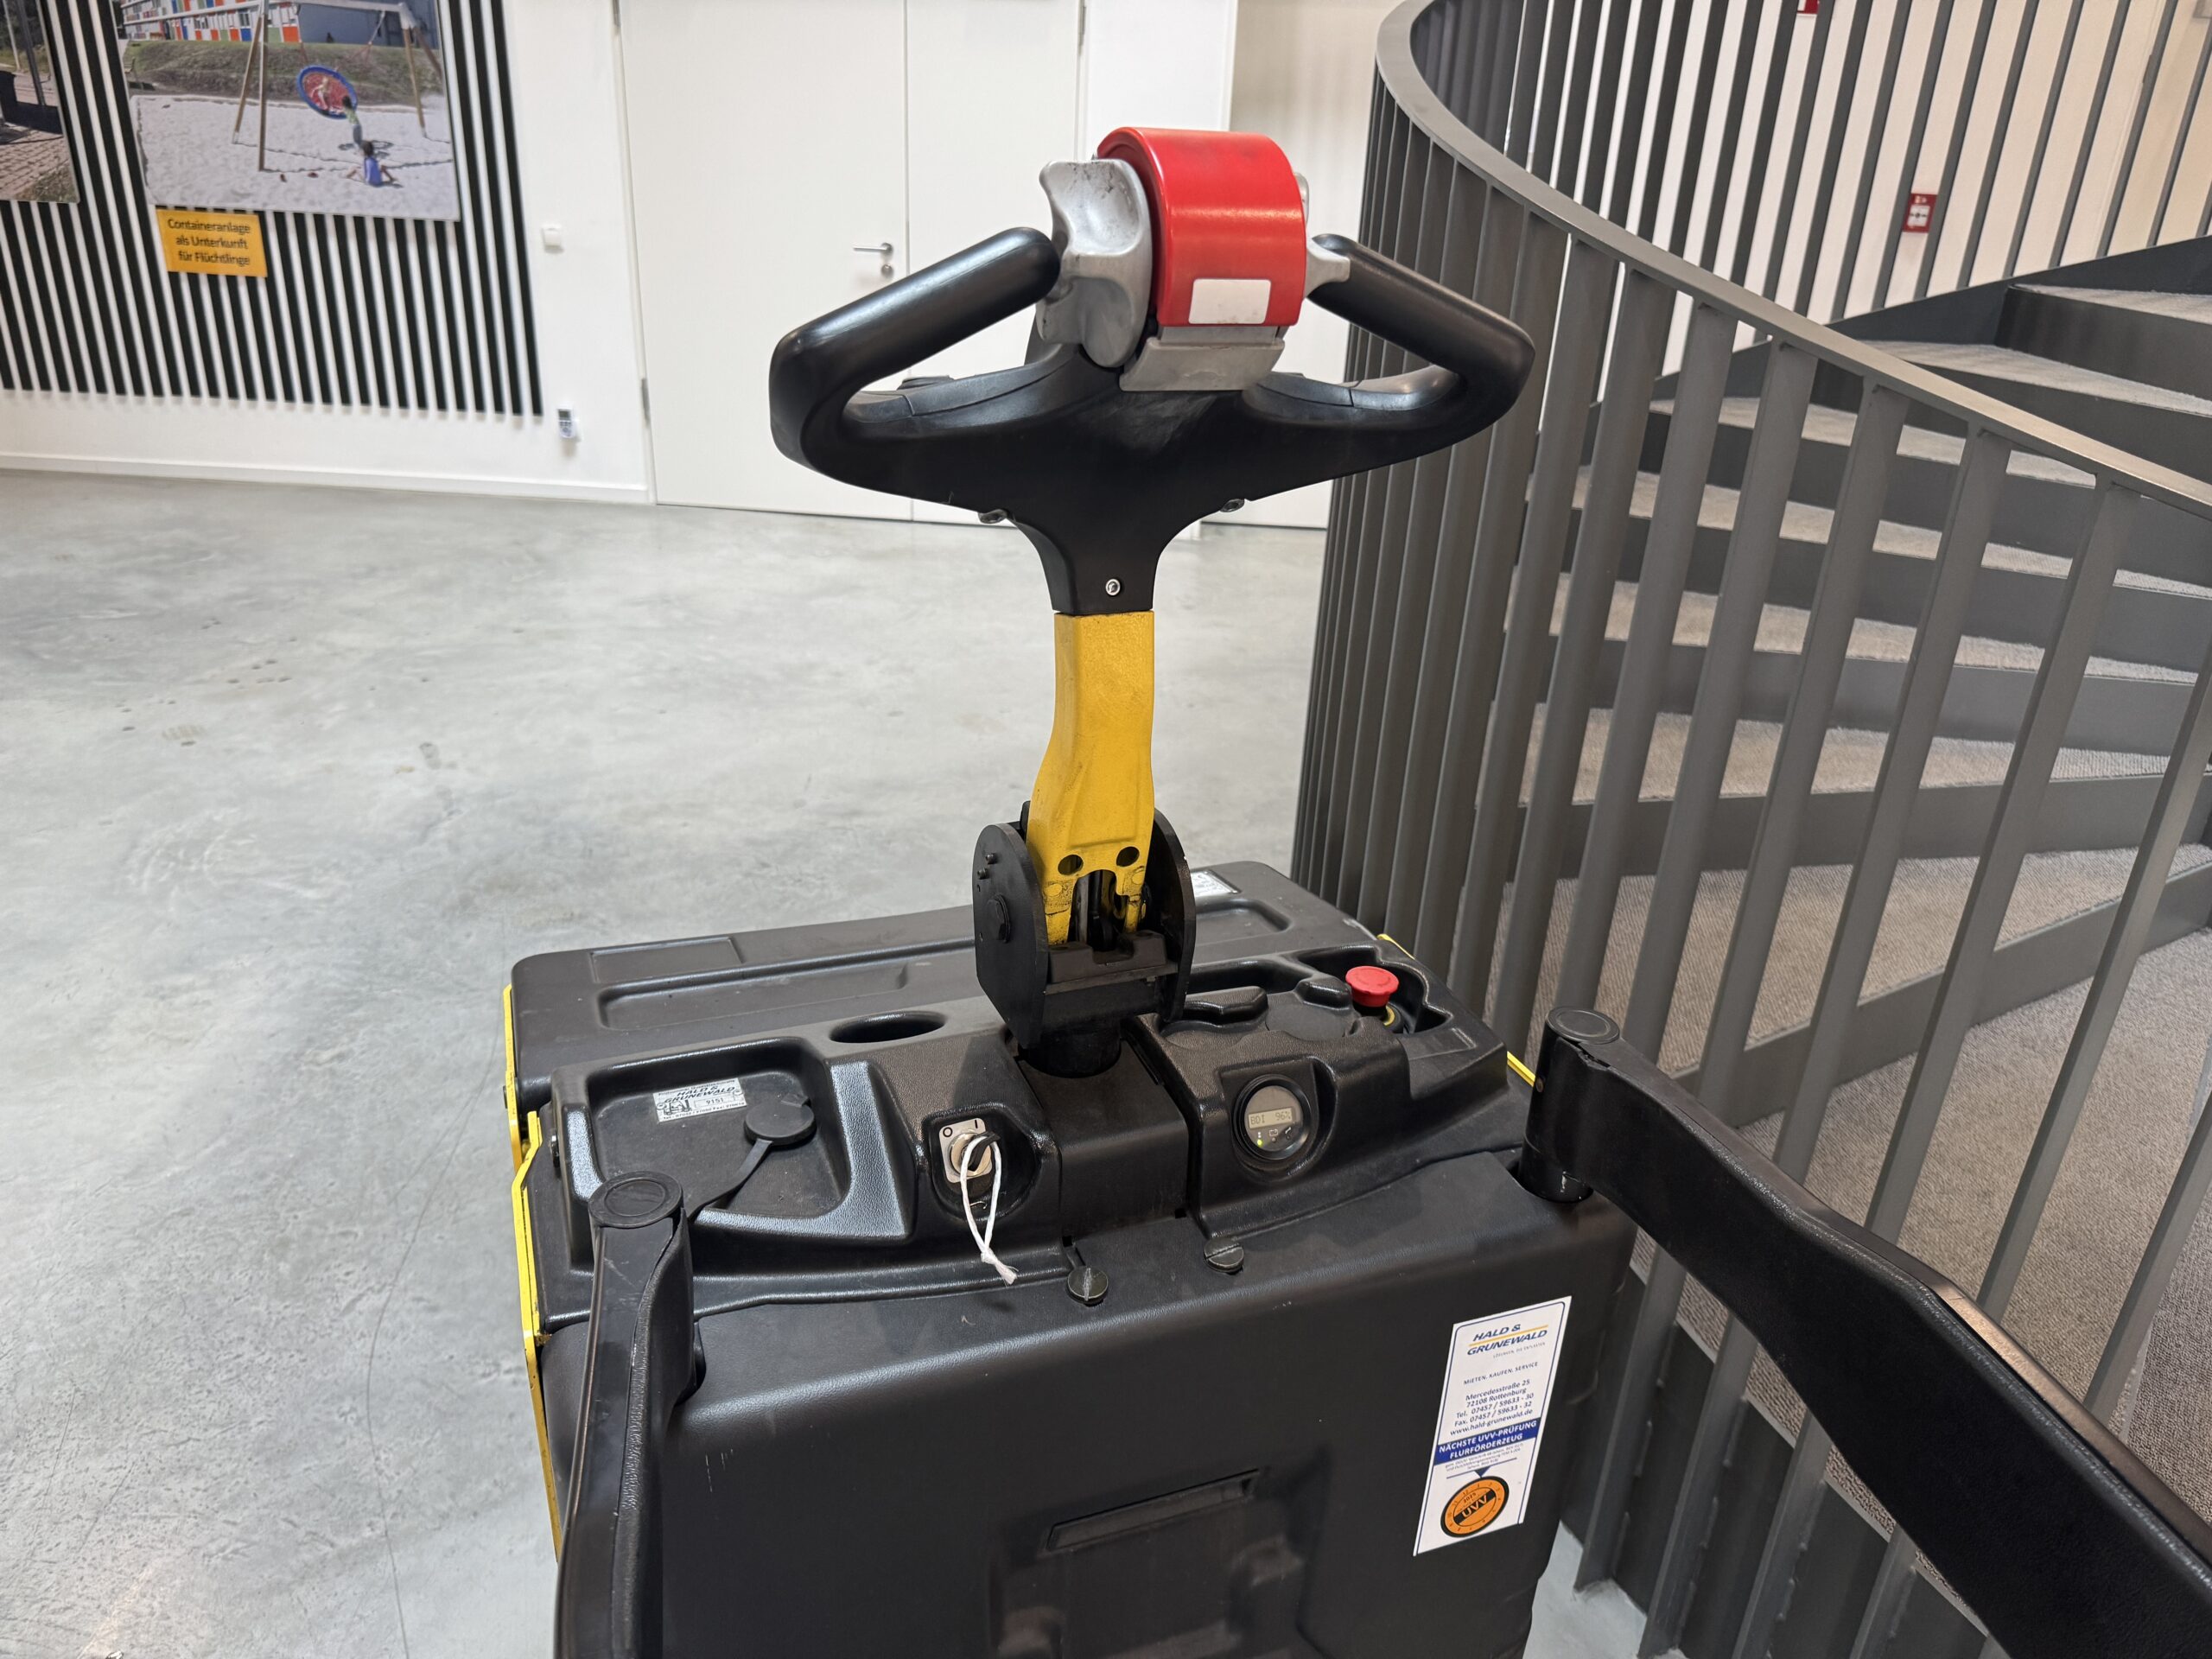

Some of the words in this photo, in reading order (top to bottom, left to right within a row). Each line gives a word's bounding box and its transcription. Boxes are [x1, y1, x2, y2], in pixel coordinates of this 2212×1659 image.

[168, 219, 251, 235] Containeranlage
[176, 235, 189, 245] als
[192, 237, 248, 249] Unterkunft
[179, 251, 192, 261] für
[195, 252, 250, 267] Flüchtlinge
[664, 1087, 735, 1103] GRUNEWALD
[677, 1087, 709, 1096] HALD
[1250, 1115, 1265, 1125] BDI
[1275, 1110, 1291, 1121] 96%
[1473, 1326, 1509, 1341] HALD
[1467, 1330, 1548, 1355] GRUNEWALD
[1515, 1362, 1538, 1372] SERVICE
[1465, 1382, 1521, 1401] Mercedesstraße
[1466, 1398, 1487, 1408] 72108
[1489, 1388, 1527, 1402] Rottenburg
[1470, 1412, 1491, 1422] 07457
[1497, 1405, 1518, 1415] 59633
[1471, 1403, 1492, 1414] 07457
[1499, 1396, 1520, 1408] 59633
[1450, 1408, 1533, 1435] www.hald-grunewald.de
[1439, 1437, 1477, 1453] NÄCHSTE
[1478, 1420, 1537, 1442] UVV-PRÜFUNG
[1449, 1433, 1523, 1459] FLURFÖRDERZEUG
[1461, 1494, 1487, 1518] UVV
